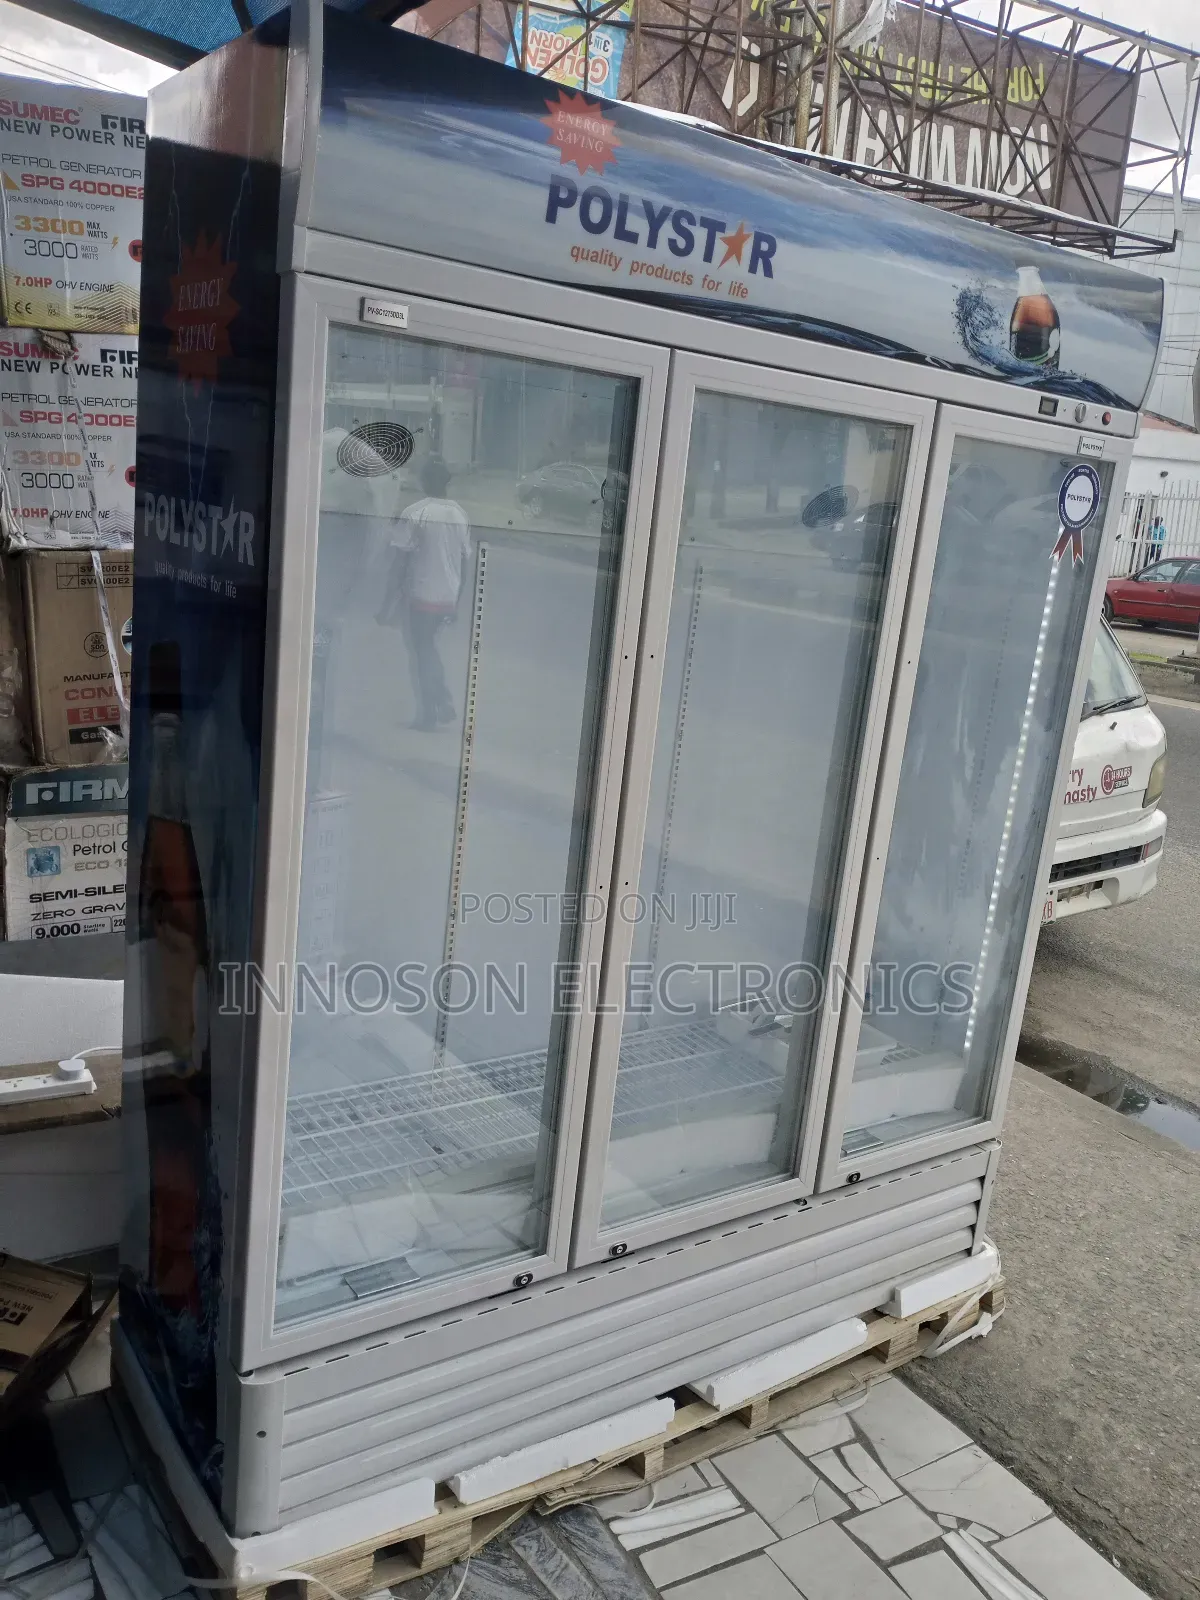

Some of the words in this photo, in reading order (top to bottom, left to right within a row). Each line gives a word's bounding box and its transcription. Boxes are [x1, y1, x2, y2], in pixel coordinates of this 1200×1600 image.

[0, 98, 80, 125] SUMEC
[0, 116, 42, 136] NEW
[50, 124, 116, 147] POWER
[556, 110, 609, 137] ENERGY
[556, 128, 605, 154] SAVING
[1, 153, 57, 170] PETROL
[59, 160, 142, 180] GENERATOR
[21, 172, 65, 191] SPG
[23, 196, 64, 207] STANDARD
[66, 200, 84, 210] 100%
[86, 202, 115, 212] COPPER
[14, 214, 85, 236] 3300
[86, 221, 101, 230] MAX
[87, 230, 108, 239] WATTS
[24, 238, 78, 259] 3000
[81, 244, 99, 252] RATED
[82, 252, 99, 260] WATTS
[570, 243, 623, 272] quality
[629, 257, 694, 286] products
[701, 274, 723, 292] for
[727, 280, 749, 299] life
[13, 275, 53, 288] 7.0HP
[55, 279, 78, 290] OHV
[79, 281, 115, 293] ENGINE
[178, 277, 224, 312] ENERGY
[176, 322, 217, 353] SAVING
[0, 358, 42, 374] NEW
[1, 392, 56, 405] PETROL
[20, 409, 63, 425] SPG
[66, 412, 137, 428] 4000E
[22, 432, 62, 440] STANDARD
[87, 434, 112, 442] OPPER
[12, 449, 82, 467] 3300
[21, 472, 75, 489] 3000
[52, 509, 74, 519] OHV
[178, 568, 207, 588] products
[210, 575, 222, 593] for
[225, 580, 237, 599] life
[73, 841, 116, 857] Petrol
[74, 860, 110, 872] ECO
[29, 884, 126, 904] SEMI-SILE
[31, 908, 76, 921] ZERO
[35, 922, 81, 939] 9.000
